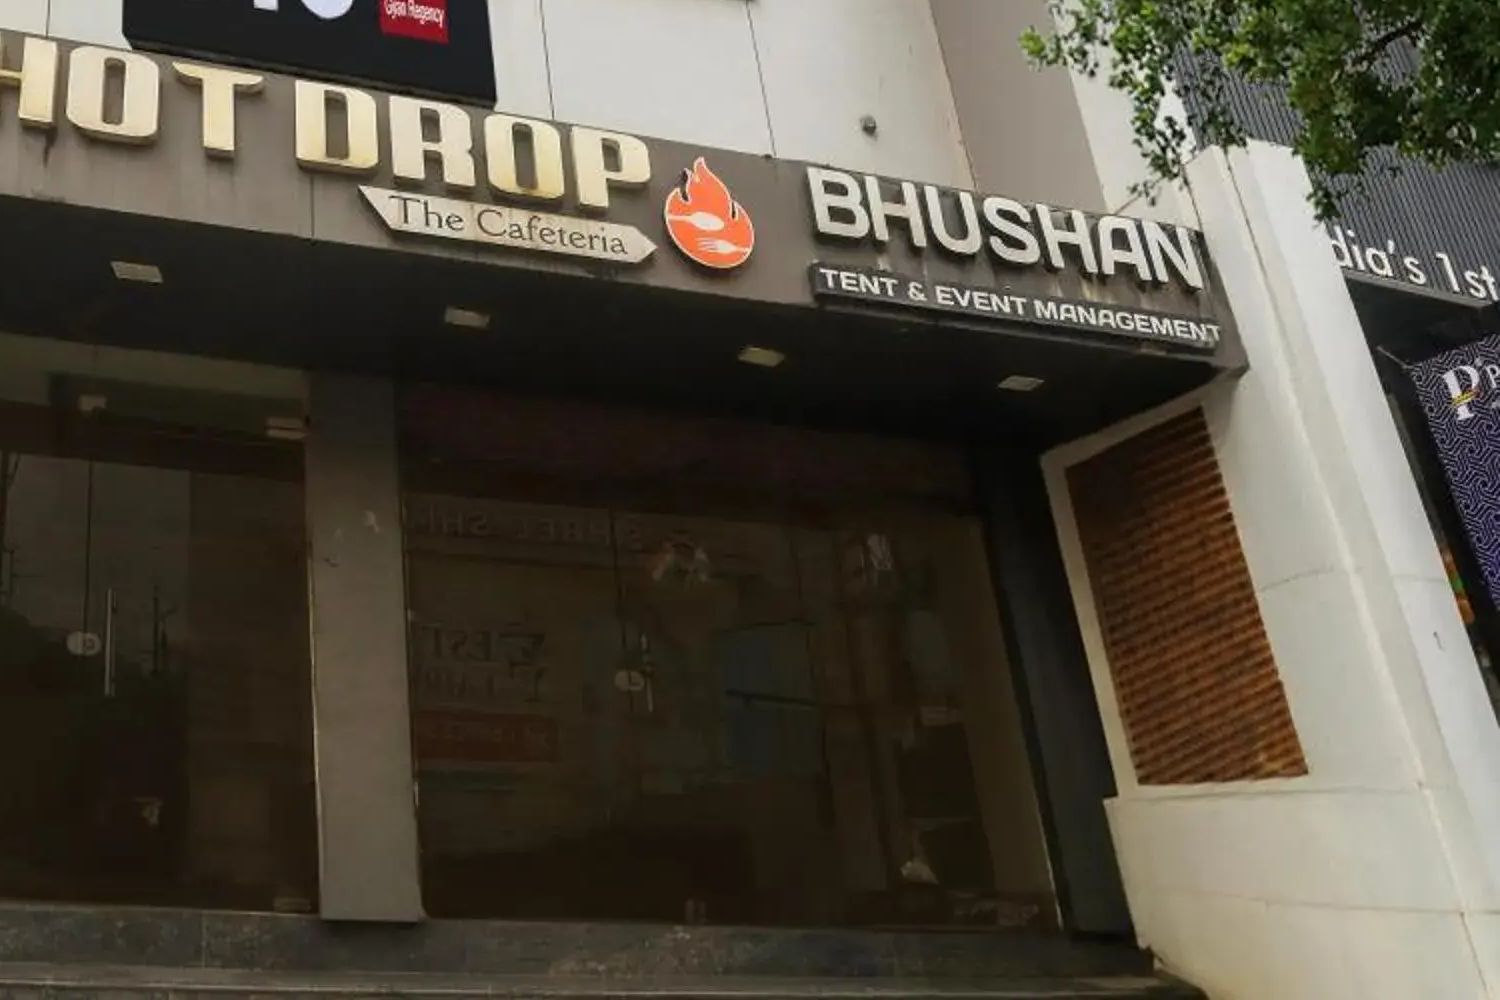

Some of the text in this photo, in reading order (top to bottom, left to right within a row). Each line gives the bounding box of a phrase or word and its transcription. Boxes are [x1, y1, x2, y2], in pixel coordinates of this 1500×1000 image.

[295, 78, 651, 208] DROP
[388, 194, 628, 256] The Cafeteria
[805, 165, 1204, 291] BHUSHAN
[818, 267, 1222, 345] TENT & EVENT MANAGEMENT
[1434, 251, 1500, 303] 1st
